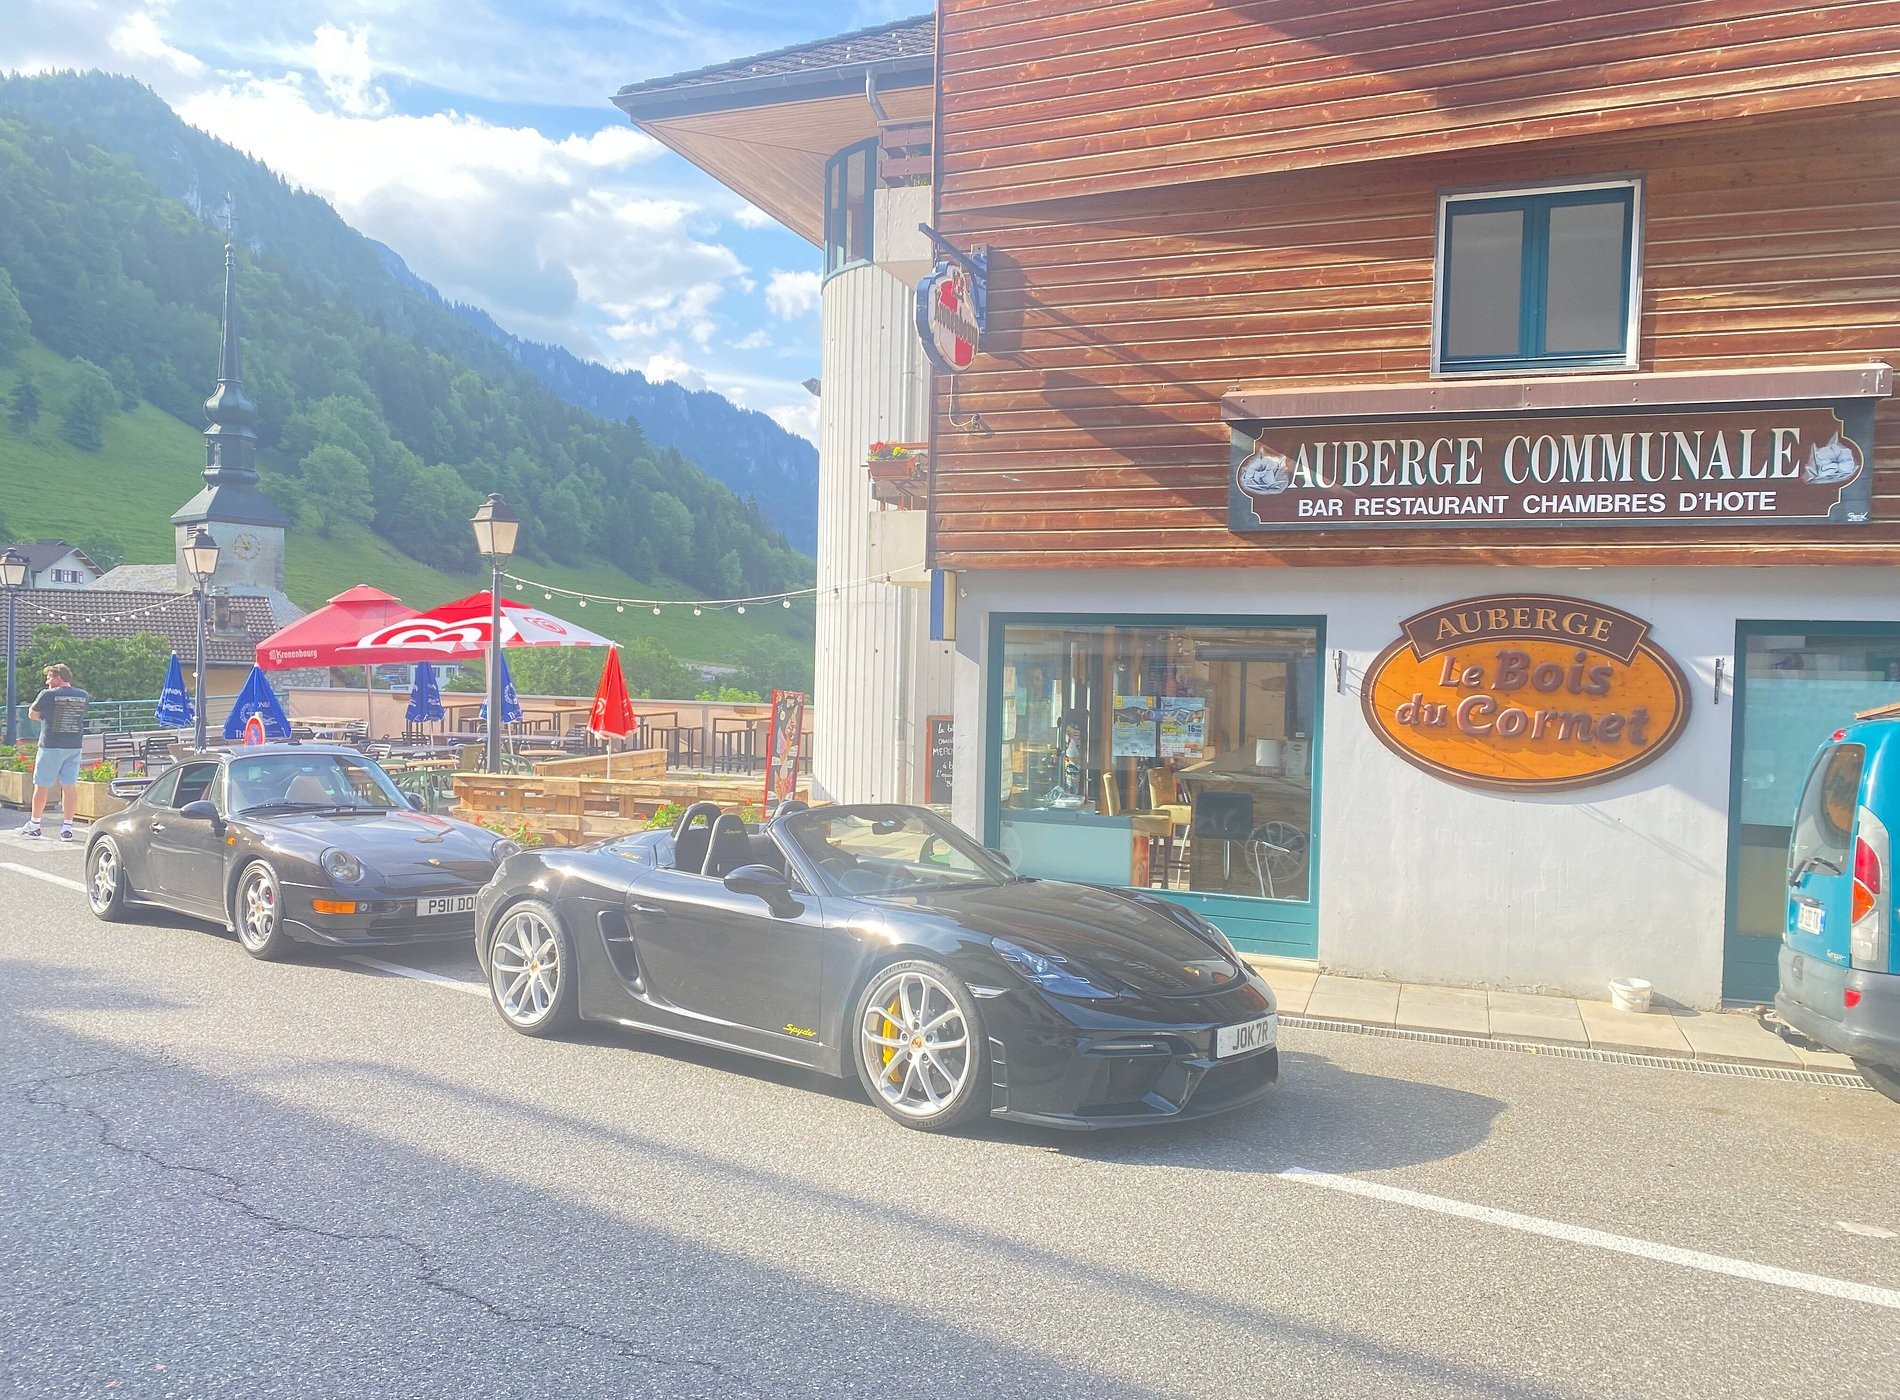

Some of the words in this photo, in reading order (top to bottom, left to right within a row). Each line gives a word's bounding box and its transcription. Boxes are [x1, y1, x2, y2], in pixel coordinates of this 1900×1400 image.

[1288, 437, 1483, 490] AUBERGE
[1504, 427, 1801, 485] COMMUNALE
[1298, 497, 1343, 517] BAR
[1354, 495, 1510, 516] RESTAURANT
[1522, 493, 1667, 514] CHAMBRES
[1678, 491, 1777, 512] D'HOTE
[1435, 606, 1614, 643] AUBERGE
[275, 649, 318, 660] Kronenbourg
[1438, 655, 1485, 689] Le
[1490, 650, 1614, 696] Bois
[1394, 692, 1448, 727] du
[1456, 694, 1650, 746] Cornet
[428, 898, 454, 914] P911
[457, 896, 477, 911] DO
